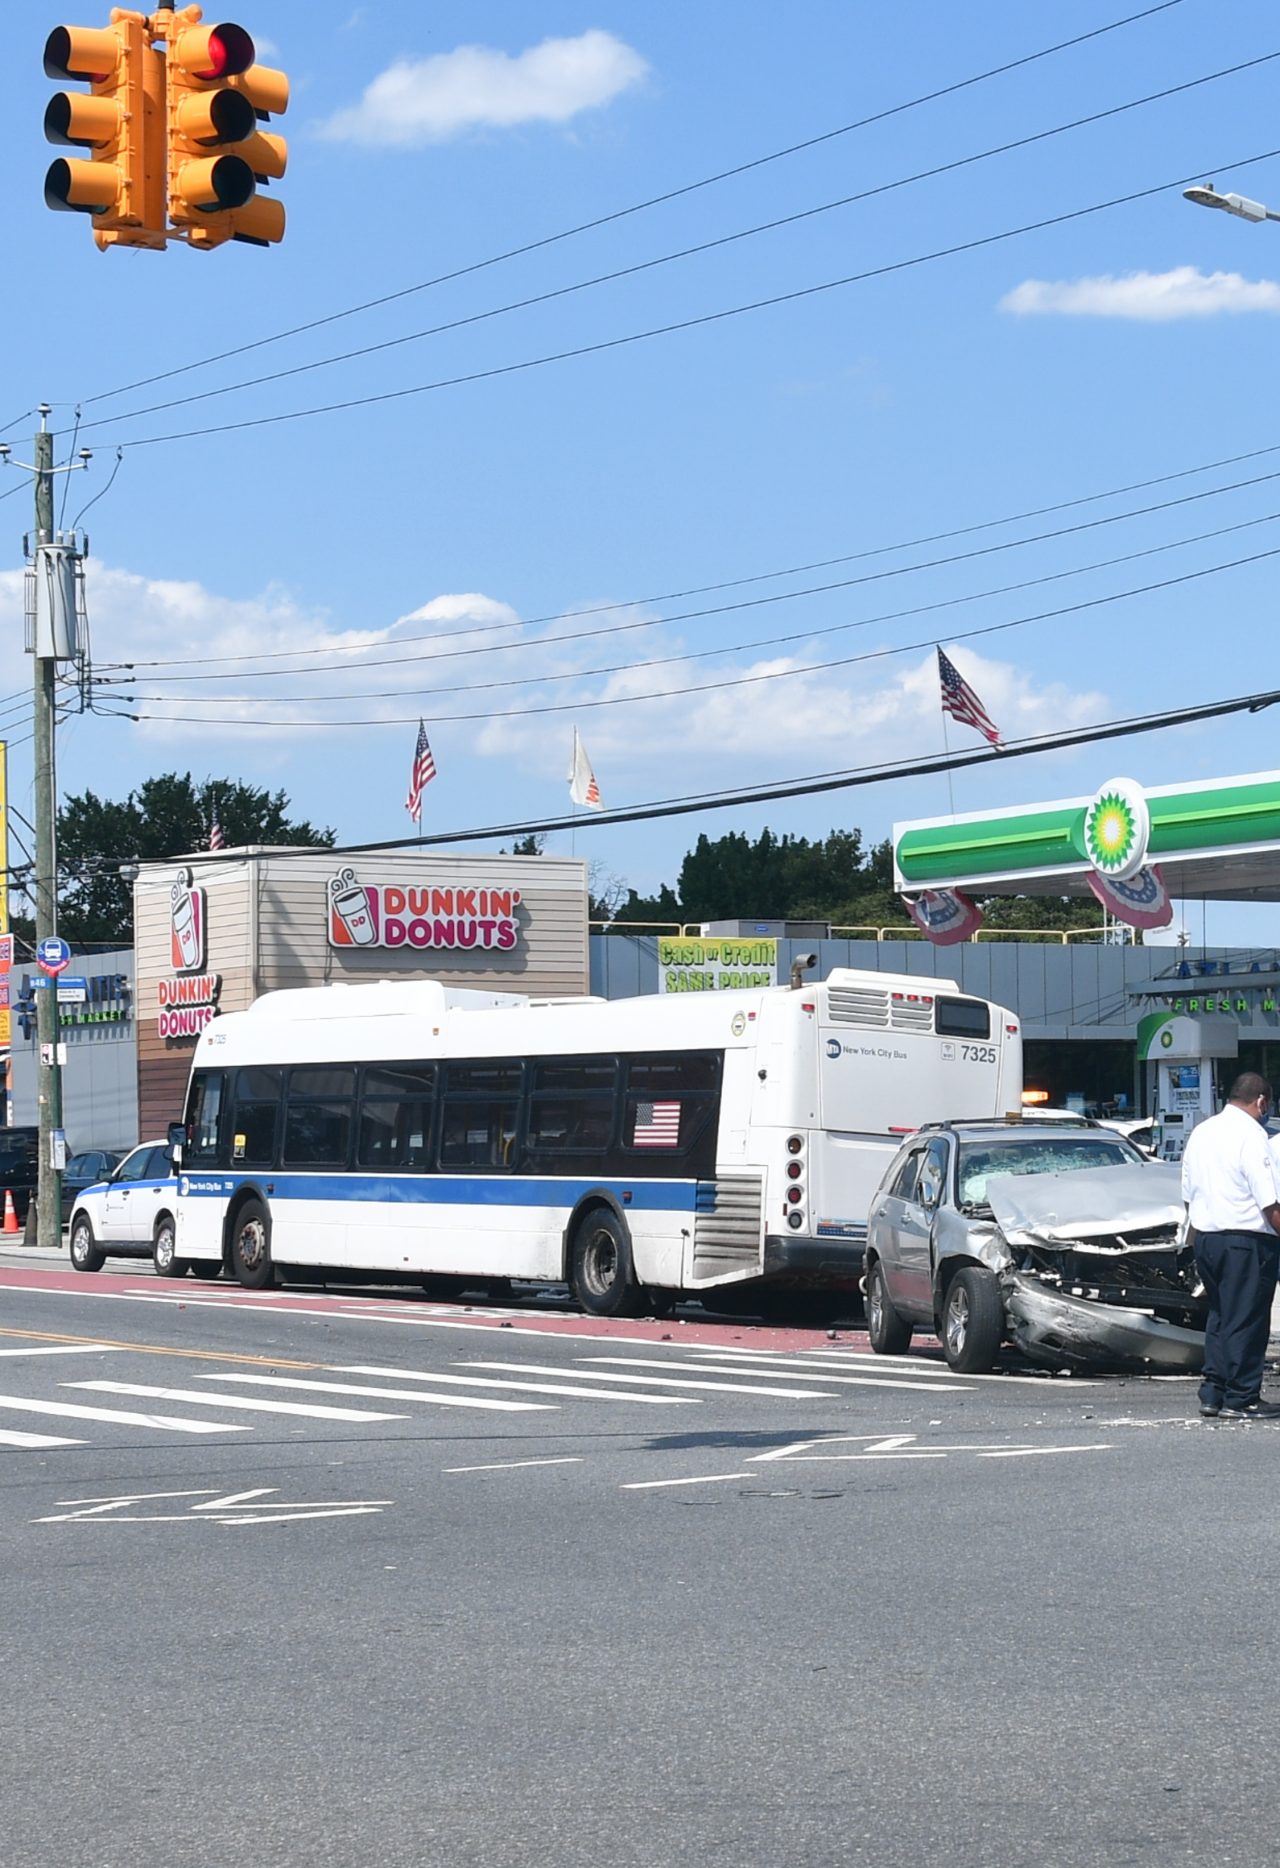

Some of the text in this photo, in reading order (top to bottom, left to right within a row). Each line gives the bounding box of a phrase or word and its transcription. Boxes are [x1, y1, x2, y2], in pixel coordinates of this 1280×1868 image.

[383, 887, 522, 917] DUNKIN'
[384, 918, 516, 947] DONUTS
[661, 942, 776, 966] Cash or Credit
[159, 978, 214, 1004] DUNKIN'
[665, 971, 770, 993] SAME PRICE
[1174, 1000, 1248, 1012] FRESH
[160, 1008, 212, 1036] DONUTS
[843, 1046, 908, 1059] New York City Bus
[961, 1045, 996, 1063] 7325
